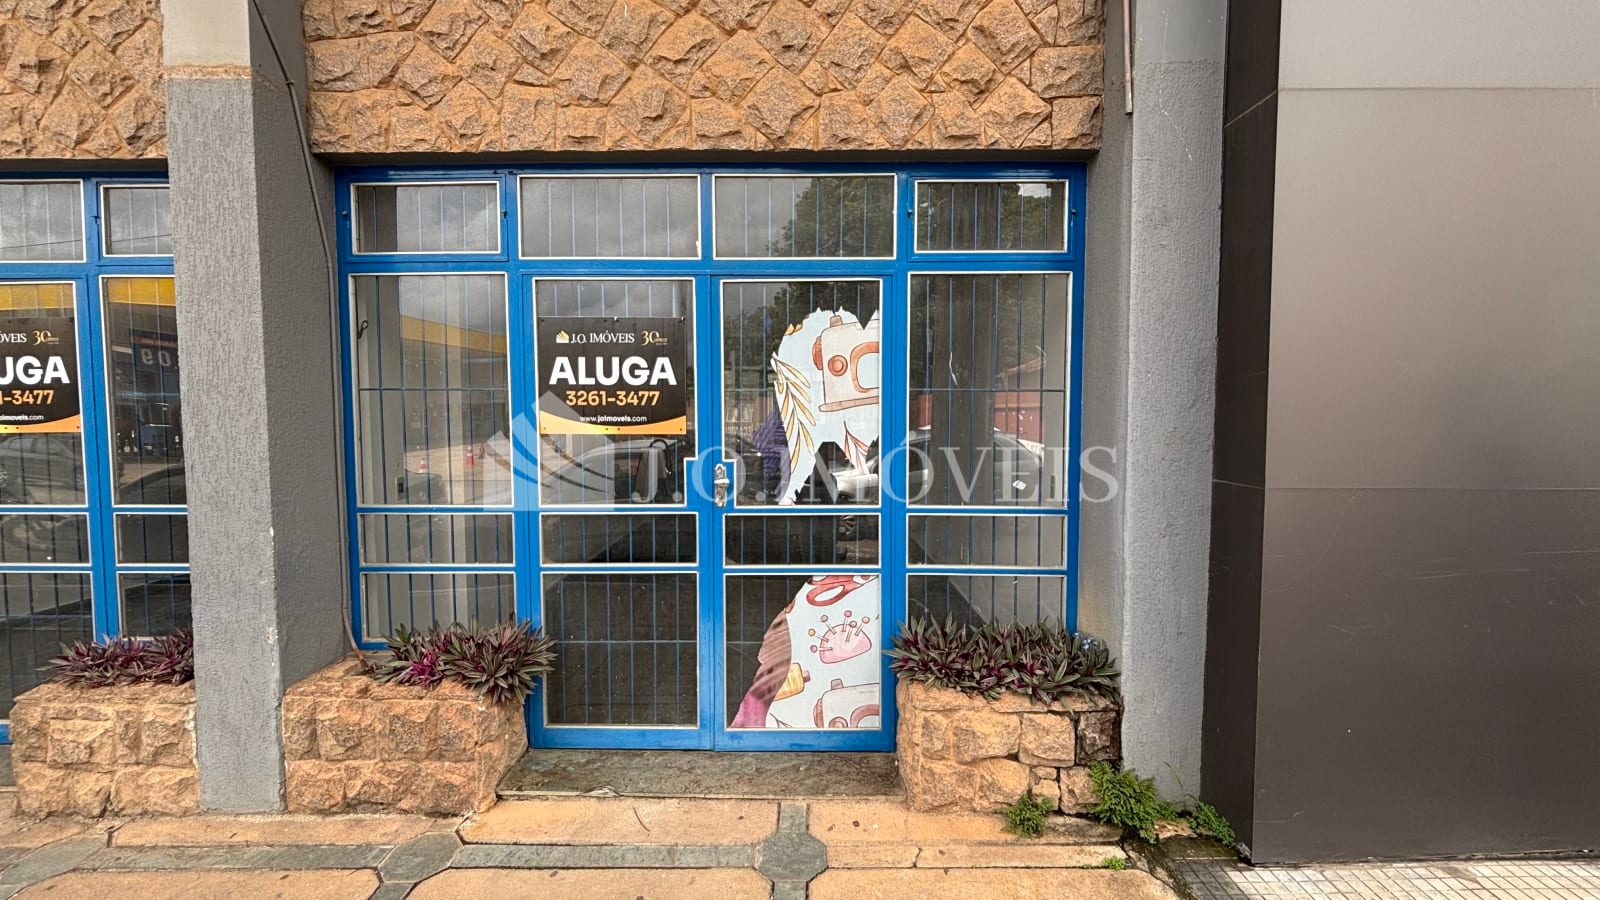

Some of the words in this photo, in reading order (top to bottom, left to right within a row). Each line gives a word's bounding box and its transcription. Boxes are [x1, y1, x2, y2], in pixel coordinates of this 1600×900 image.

[589, 329, 635, 344] IMÓVEIS
[0, 355, 70, 385] UGA
[549, 355, 678, 386] ALUGA
[565, 390, 660, 406] 3261-3477
